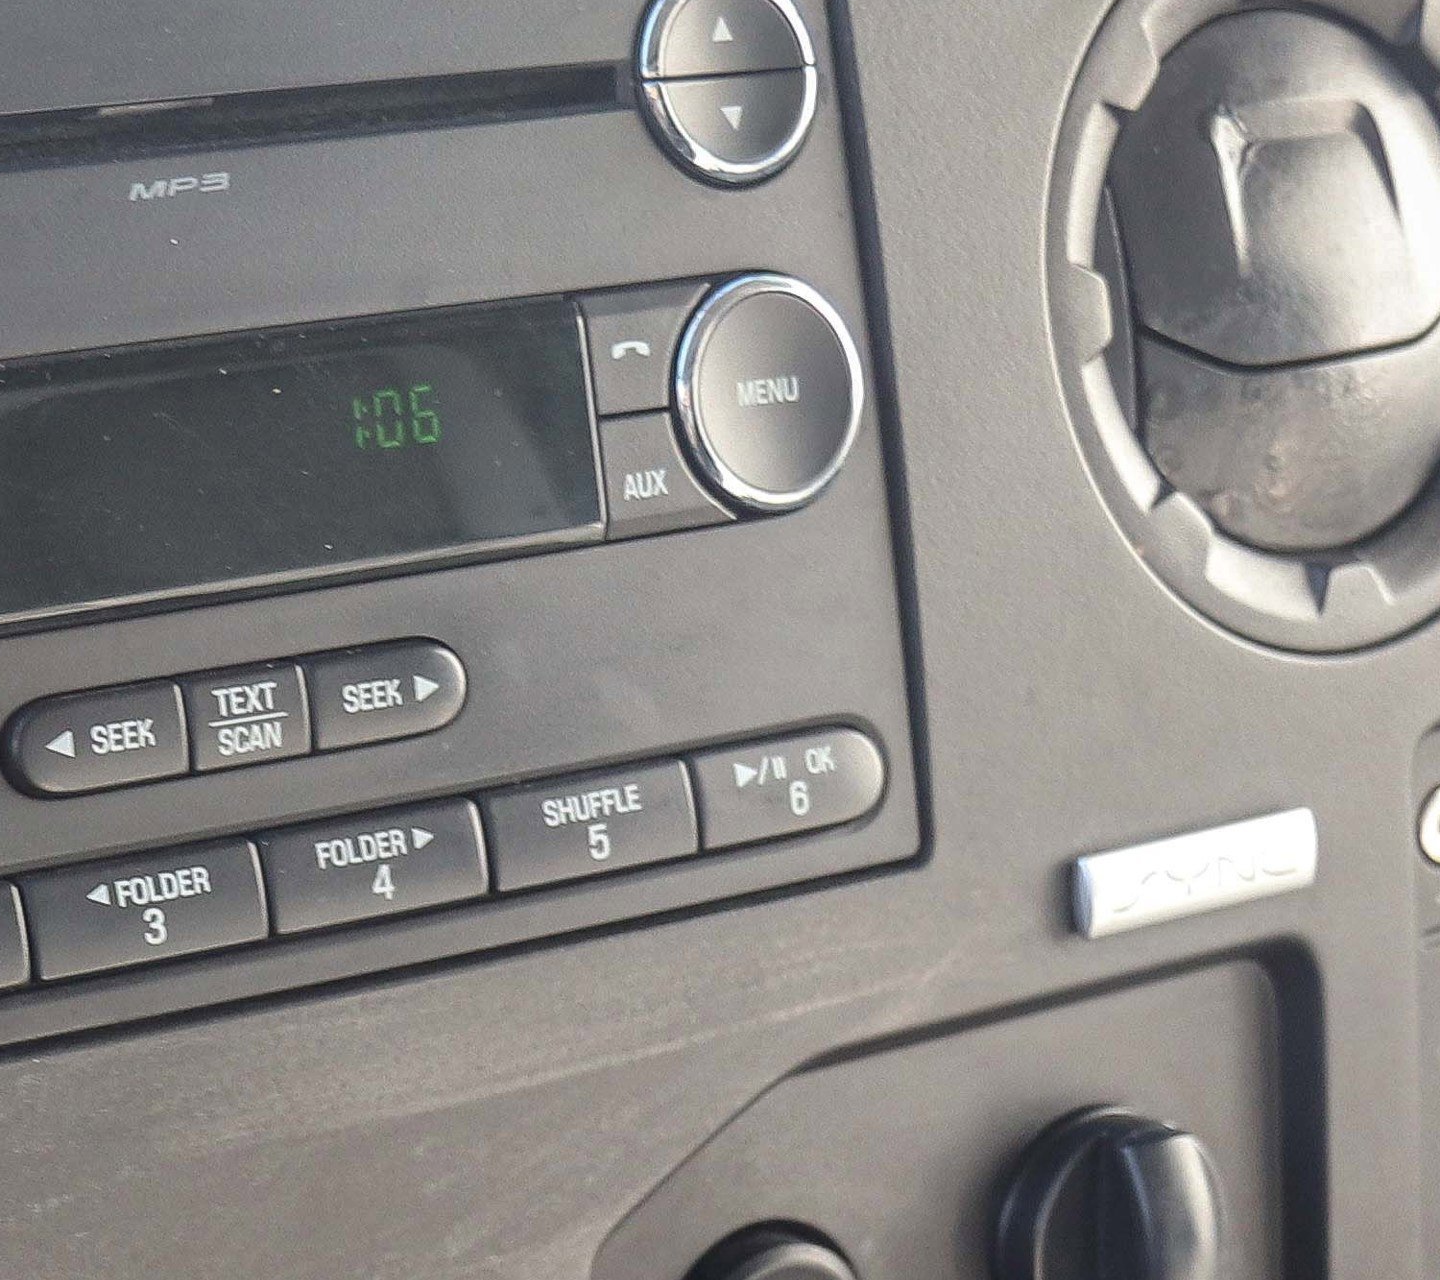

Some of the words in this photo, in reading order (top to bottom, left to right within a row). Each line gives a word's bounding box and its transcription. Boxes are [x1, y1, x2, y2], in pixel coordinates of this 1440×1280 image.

[130, 172, 229, 200] MP3
[737, 378, 797, 406] MENU
[625, 470, 668, 499] AUX
[212, 682, 277, 715] TEXT
[344, 680, 402, 712] SEEK
[91, 719, 155, 753] SEEK
[214, 722, 281, 755] SCAN
[806, 747, 834, 773] OK
[543, 786, 641, 826] SHUFFLE
[791, 781, 808, 814] 6
[315, 830, 407, 870] FOLDER
[589, 824, 610, 859] 5
[114, 867, 210, 907] FOLDER
[373, 865, 394, 899] 4
[144, 908, 166, 944] 3
